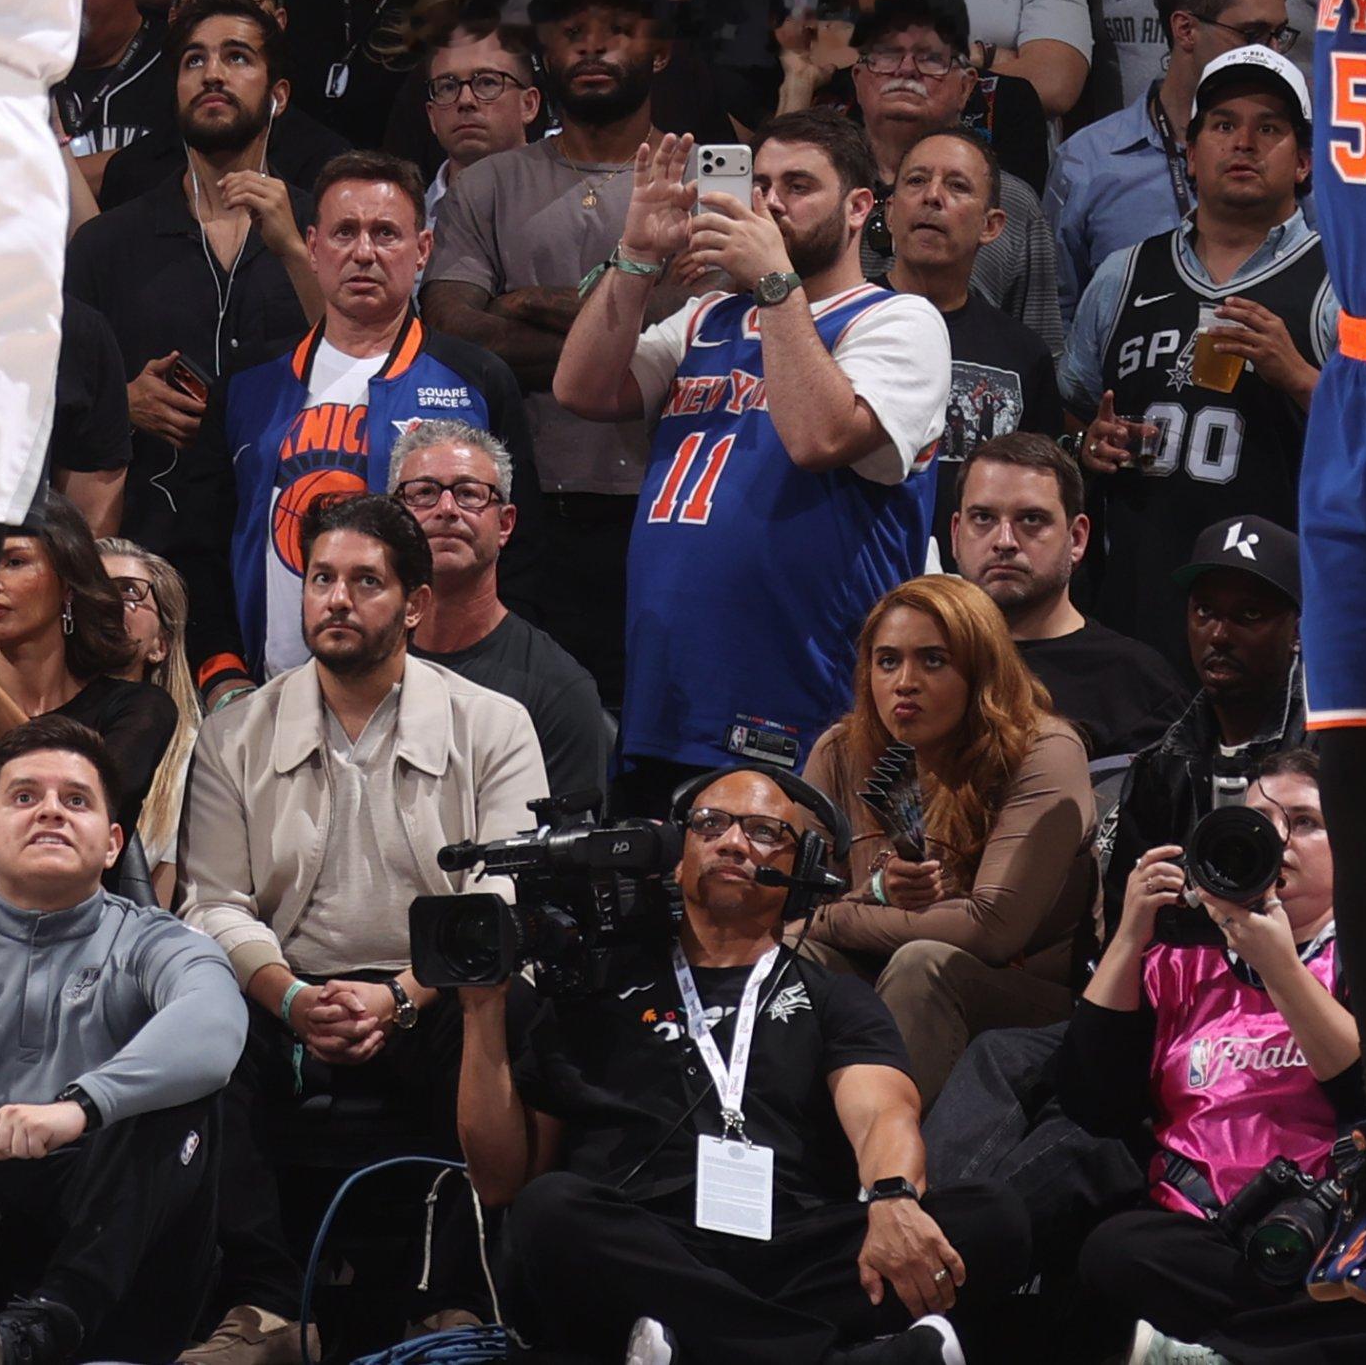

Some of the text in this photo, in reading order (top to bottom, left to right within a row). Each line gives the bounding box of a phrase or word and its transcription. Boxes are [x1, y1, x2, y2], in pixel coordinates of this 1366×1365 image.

[416, 386, 468, 399] SQUARE
[417, 396, 460, 409] SPACE
[646, 431, 737, 525] 11
[611, 840, 632, 855] HD
[1204, 1032, 1309, 1091] Finals
